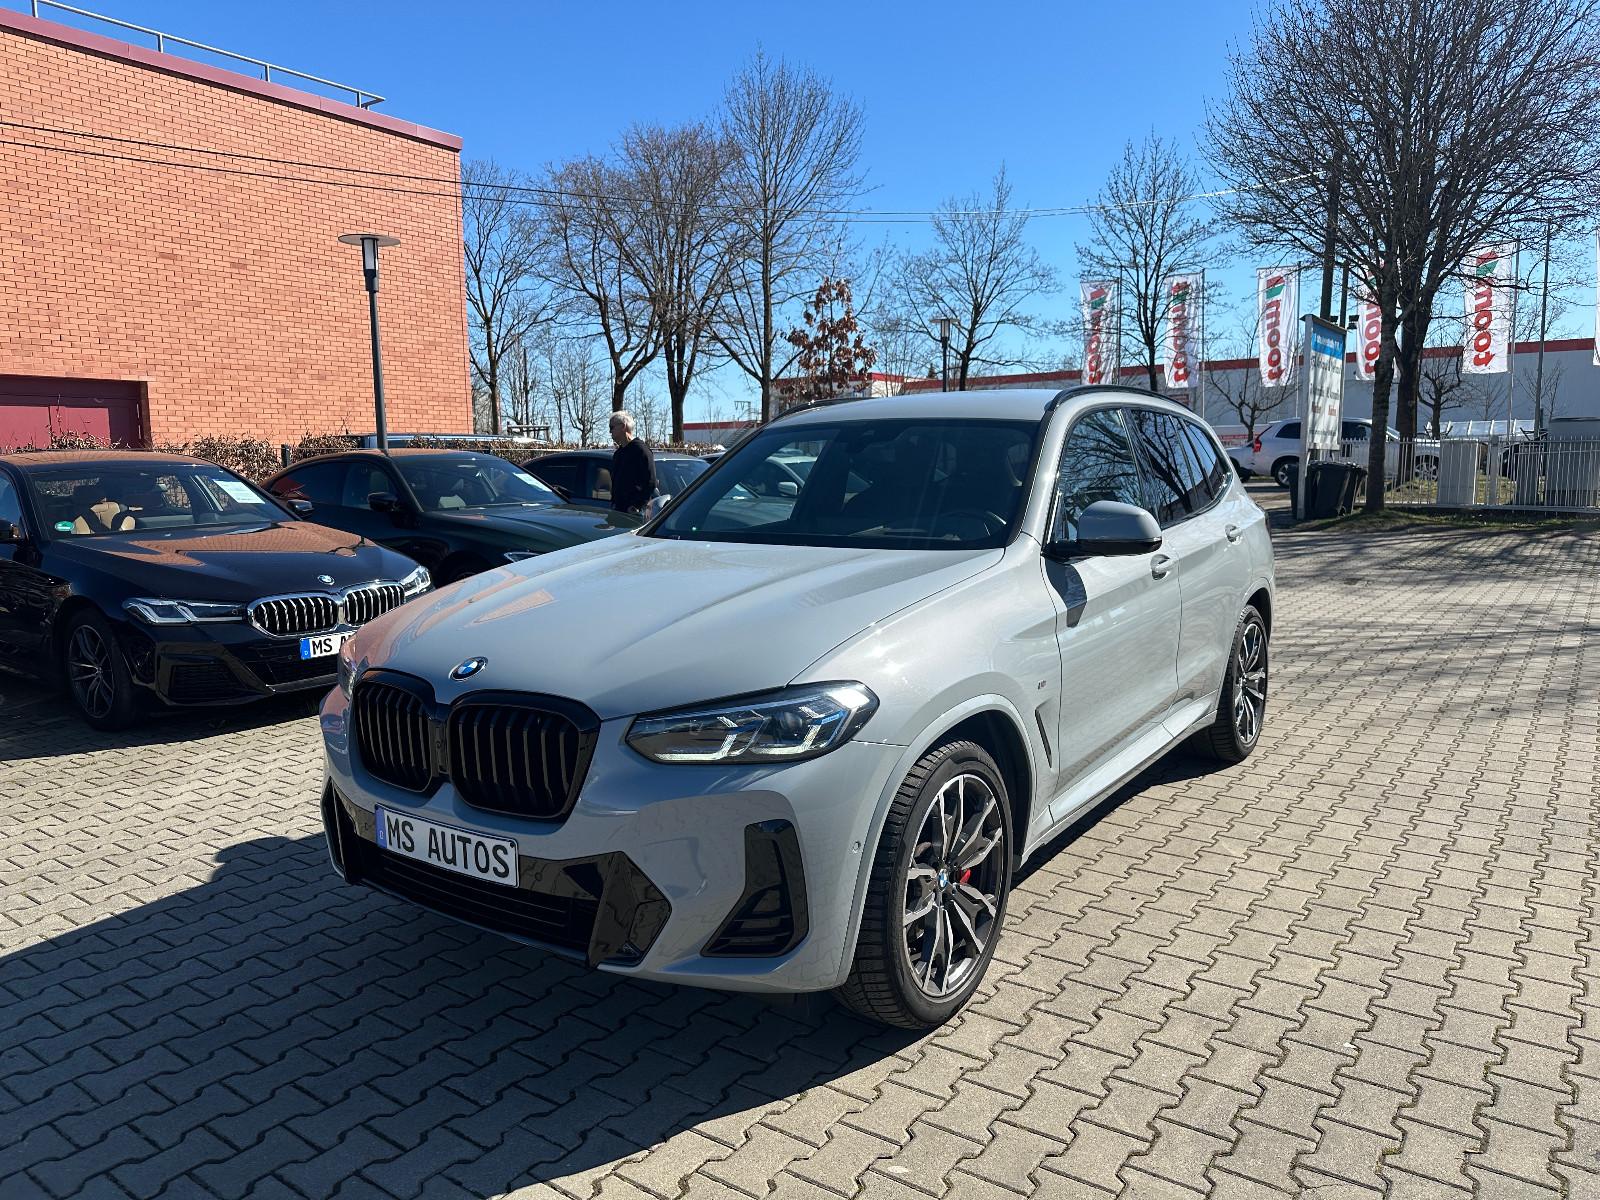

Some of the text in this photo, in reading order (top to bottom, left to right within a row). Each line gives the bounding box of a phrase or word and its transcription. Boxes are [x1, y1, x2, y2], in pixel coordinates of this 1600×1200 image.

[311, 637, 333, 655] MS
[387, 814, 510, 879] MS AUTOS
